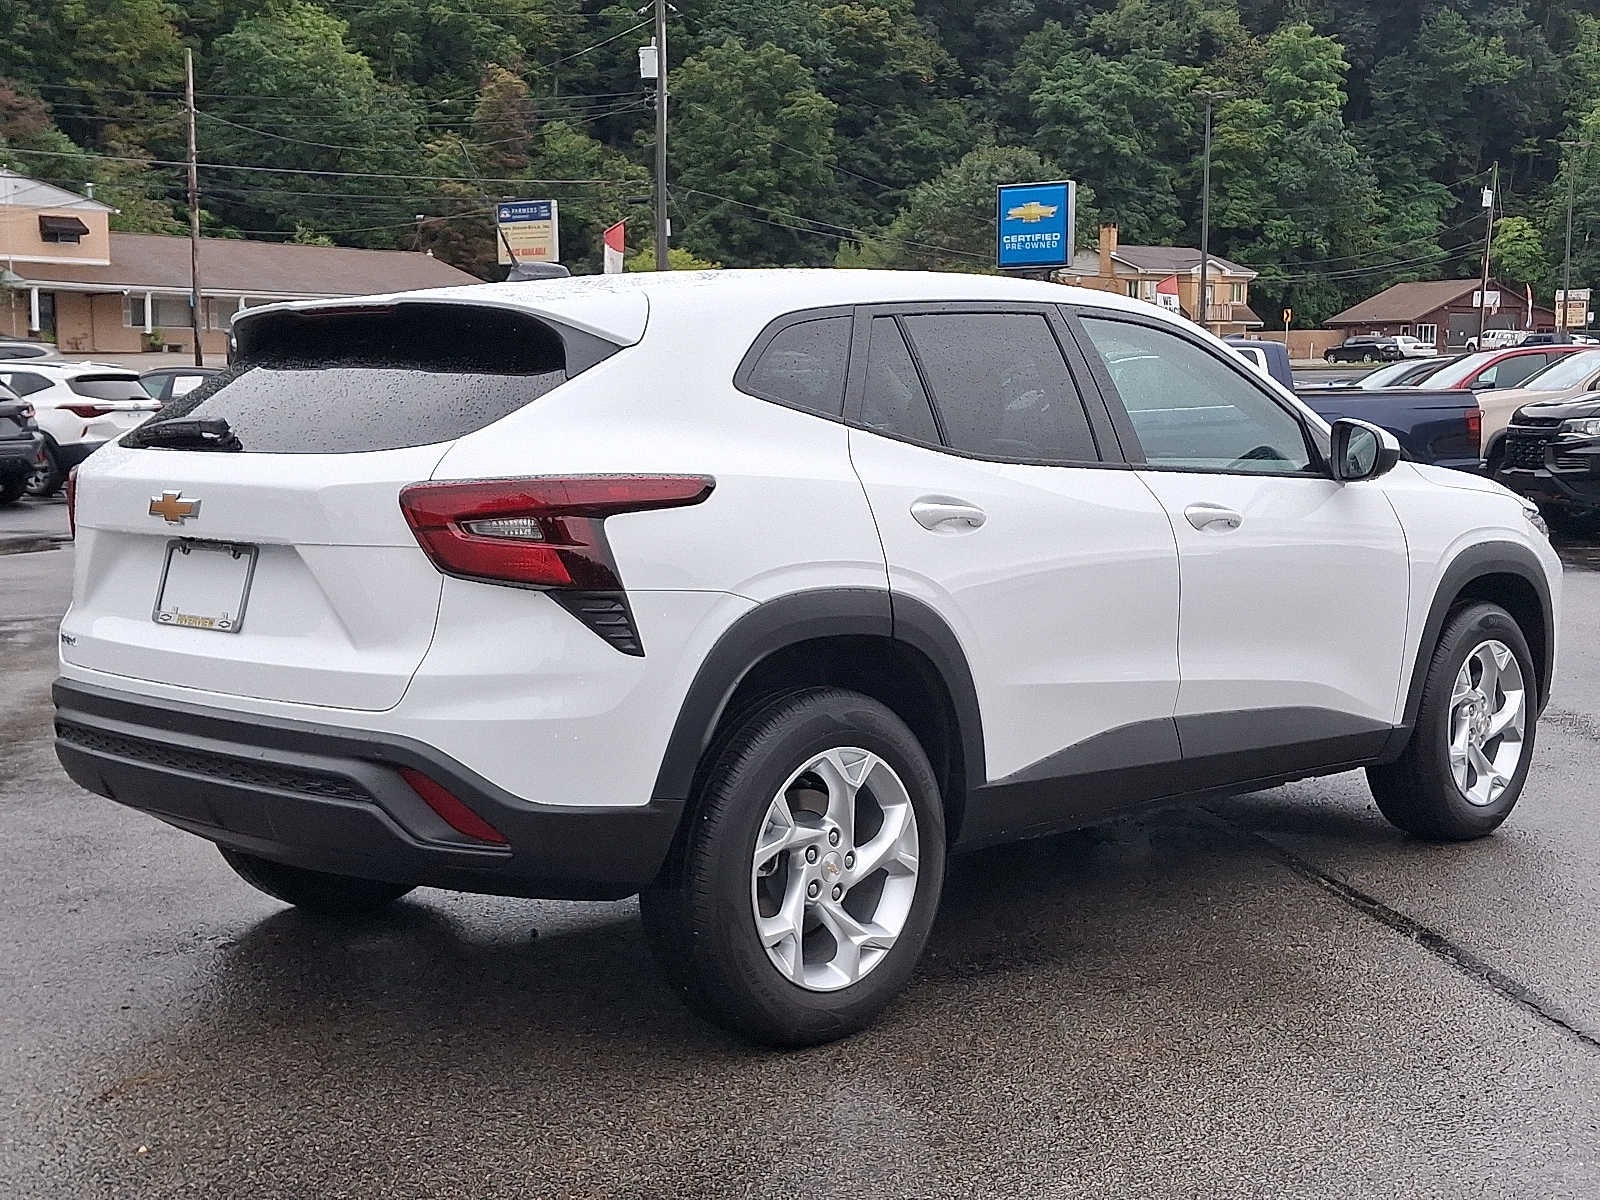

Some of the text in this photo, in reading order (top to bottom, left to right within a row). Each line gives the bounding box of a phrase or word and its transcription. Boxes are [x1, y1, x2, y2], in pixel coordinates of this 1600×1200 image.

[1003, 232, 1061, 243] CERTIFIED
[1005, 240, 1058, 251] PRE-OWNED
[1163, 296, 1172, 306] WE
